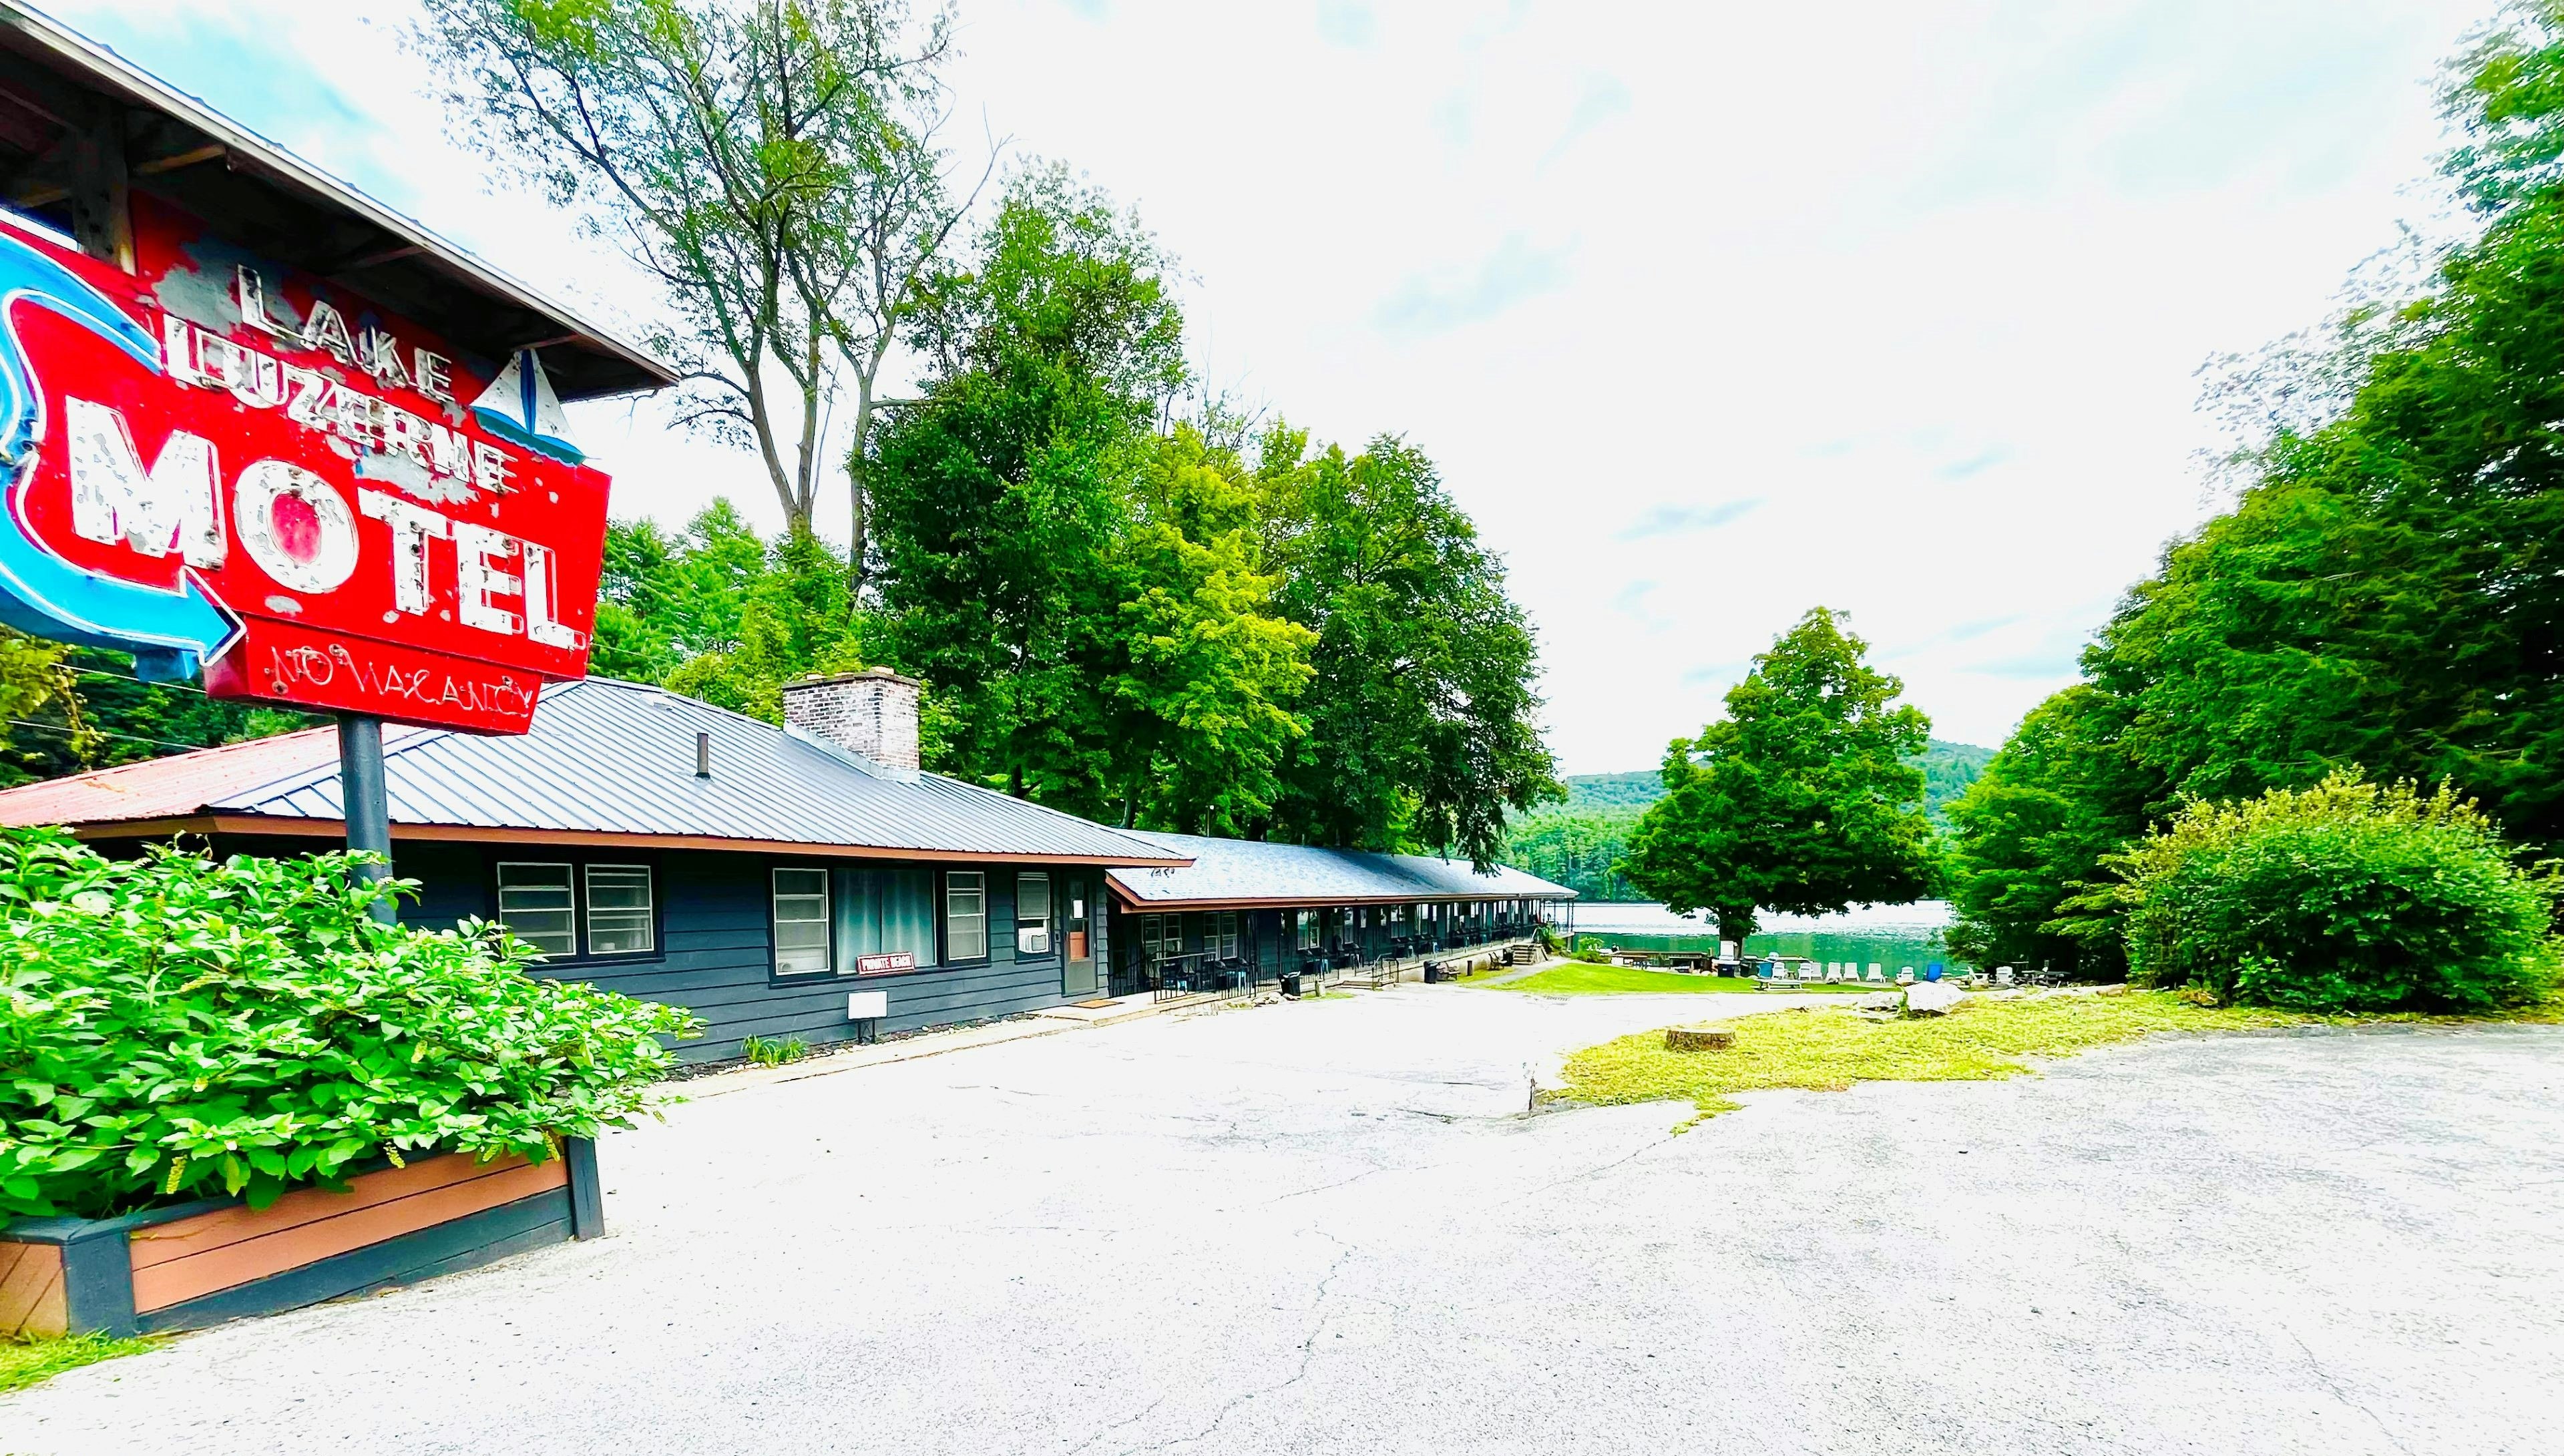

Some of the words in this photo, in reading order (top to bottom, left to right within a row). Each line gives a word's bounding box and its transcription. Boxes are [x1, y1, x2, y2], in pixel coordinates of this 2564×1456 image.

[164, 314, 519, 494] LUZERNE
[238, 264, 455, 403] LAKE
[65, 395, 586, 650] MOTEL
[269, 646, 334, 688] NO
[339, 646, 533, 717] VACANCY
